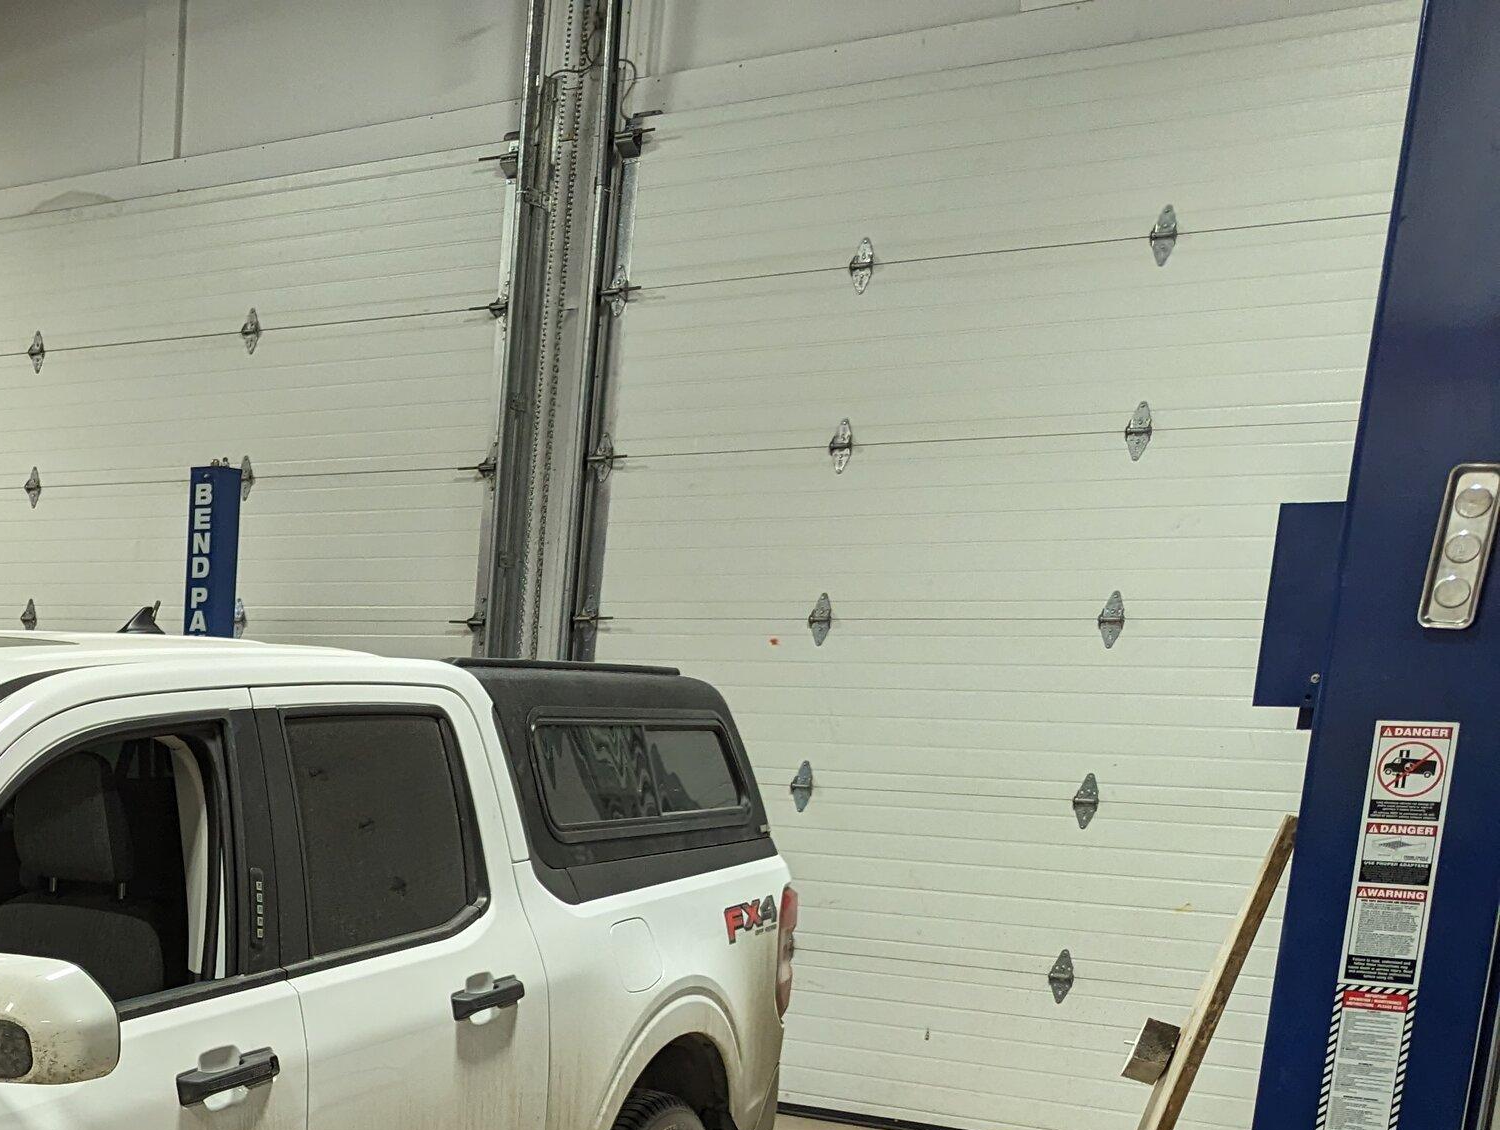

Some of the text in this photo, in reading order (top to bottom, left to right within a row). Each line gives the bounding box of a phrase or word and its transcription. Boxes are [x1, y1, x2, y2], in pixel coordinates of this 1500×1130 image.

[188, 587, 208, 637] PA
[1394, 728, 1448, 737] DANGER
[1380, 825, 1434, 835] DANGER
[1368, 889, 1425, 899] WARNING
[724, 895, 777, 944] FX4
